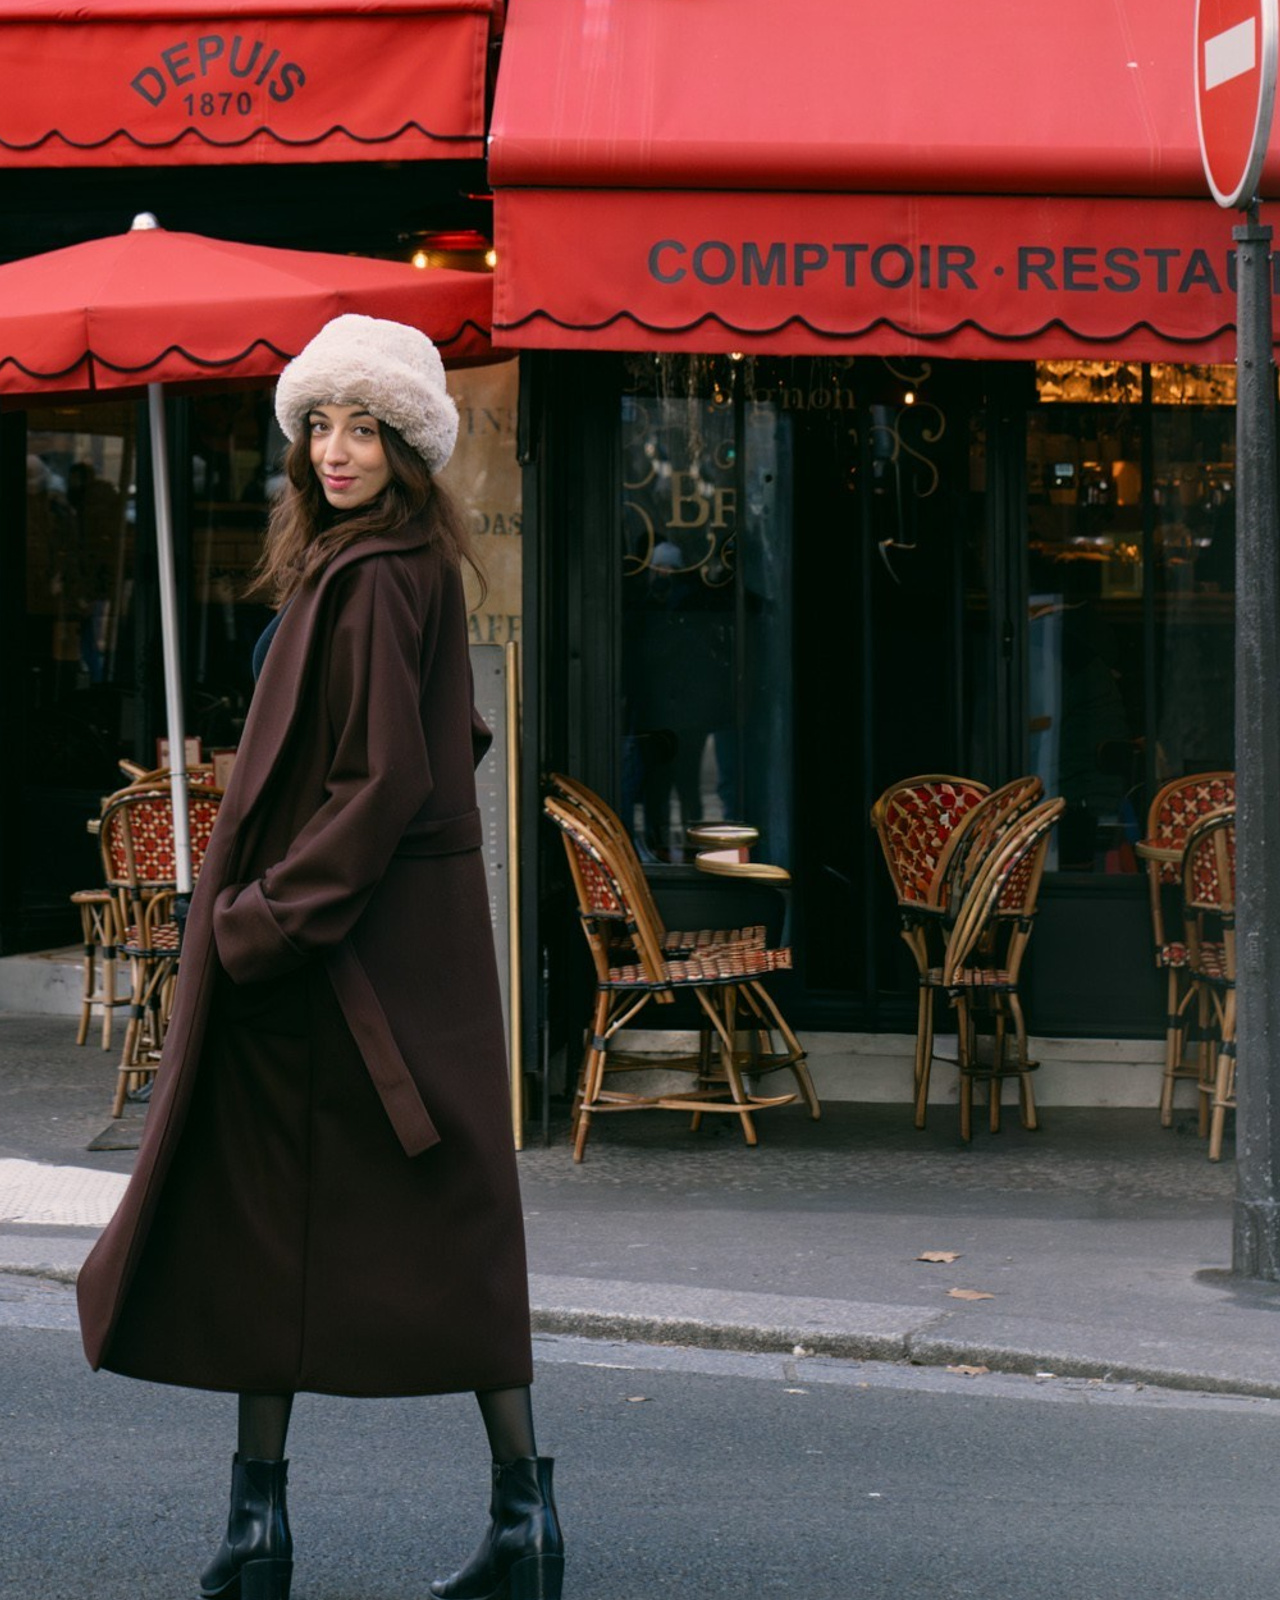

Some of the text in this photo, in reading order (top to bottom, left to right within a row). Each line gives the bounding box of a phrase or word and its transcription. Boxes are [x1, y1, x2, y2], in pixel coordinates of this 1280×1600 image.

[130, 34, 306, 108] DEPUIS
[183, 90, 253, 117] 1870
[646, 239, 1280, 296] COMPTOIR RESTA
